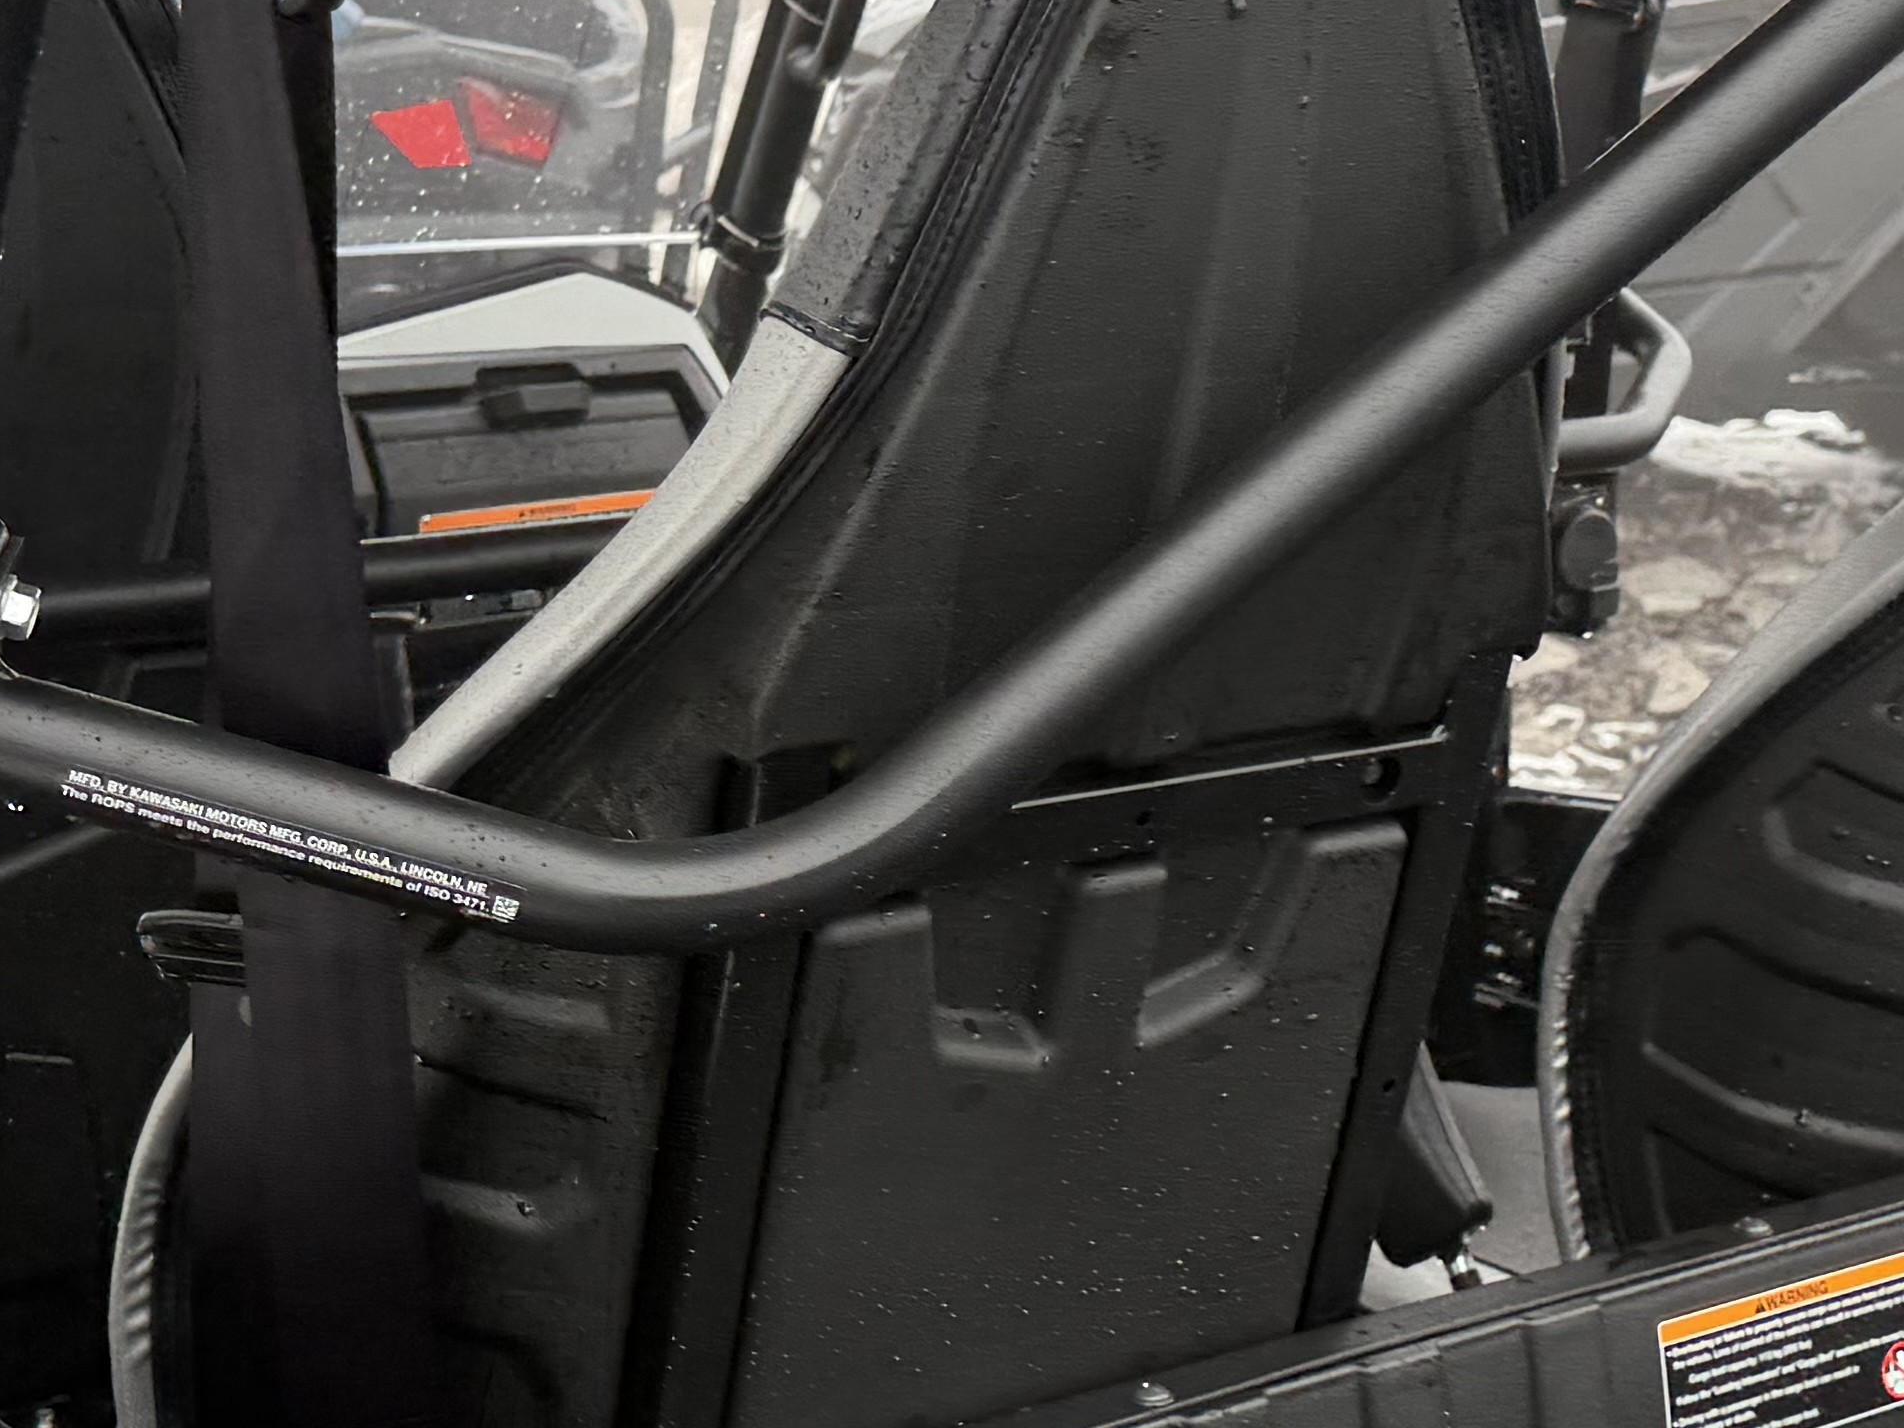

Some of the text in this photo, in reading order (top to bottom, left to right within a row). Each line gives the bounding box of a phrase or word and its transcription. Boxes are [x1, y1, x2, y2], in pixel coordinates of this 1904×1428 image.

[60, 784, 88, 801] The
[91, 793, 136, 814] ROPS
[138, 808, 183, 827] meets
[187, 820, 210, 835] the
[212, 828, 305, 860] performance
[308, 854, 403, 888] requirements
[406, 881, 422, 893] of
[424, 885, 450, 901] ISO
[68, 770, 104, 791] MFD.
[107, 780, 128, 794] BY
[129, 787, 204, 817] KAWASAKI
[206, 807, 269, 835] MOTORS
[269, 825, 304, 845] MFG.
[1766, 1280, 1829, 1310] WARNING
